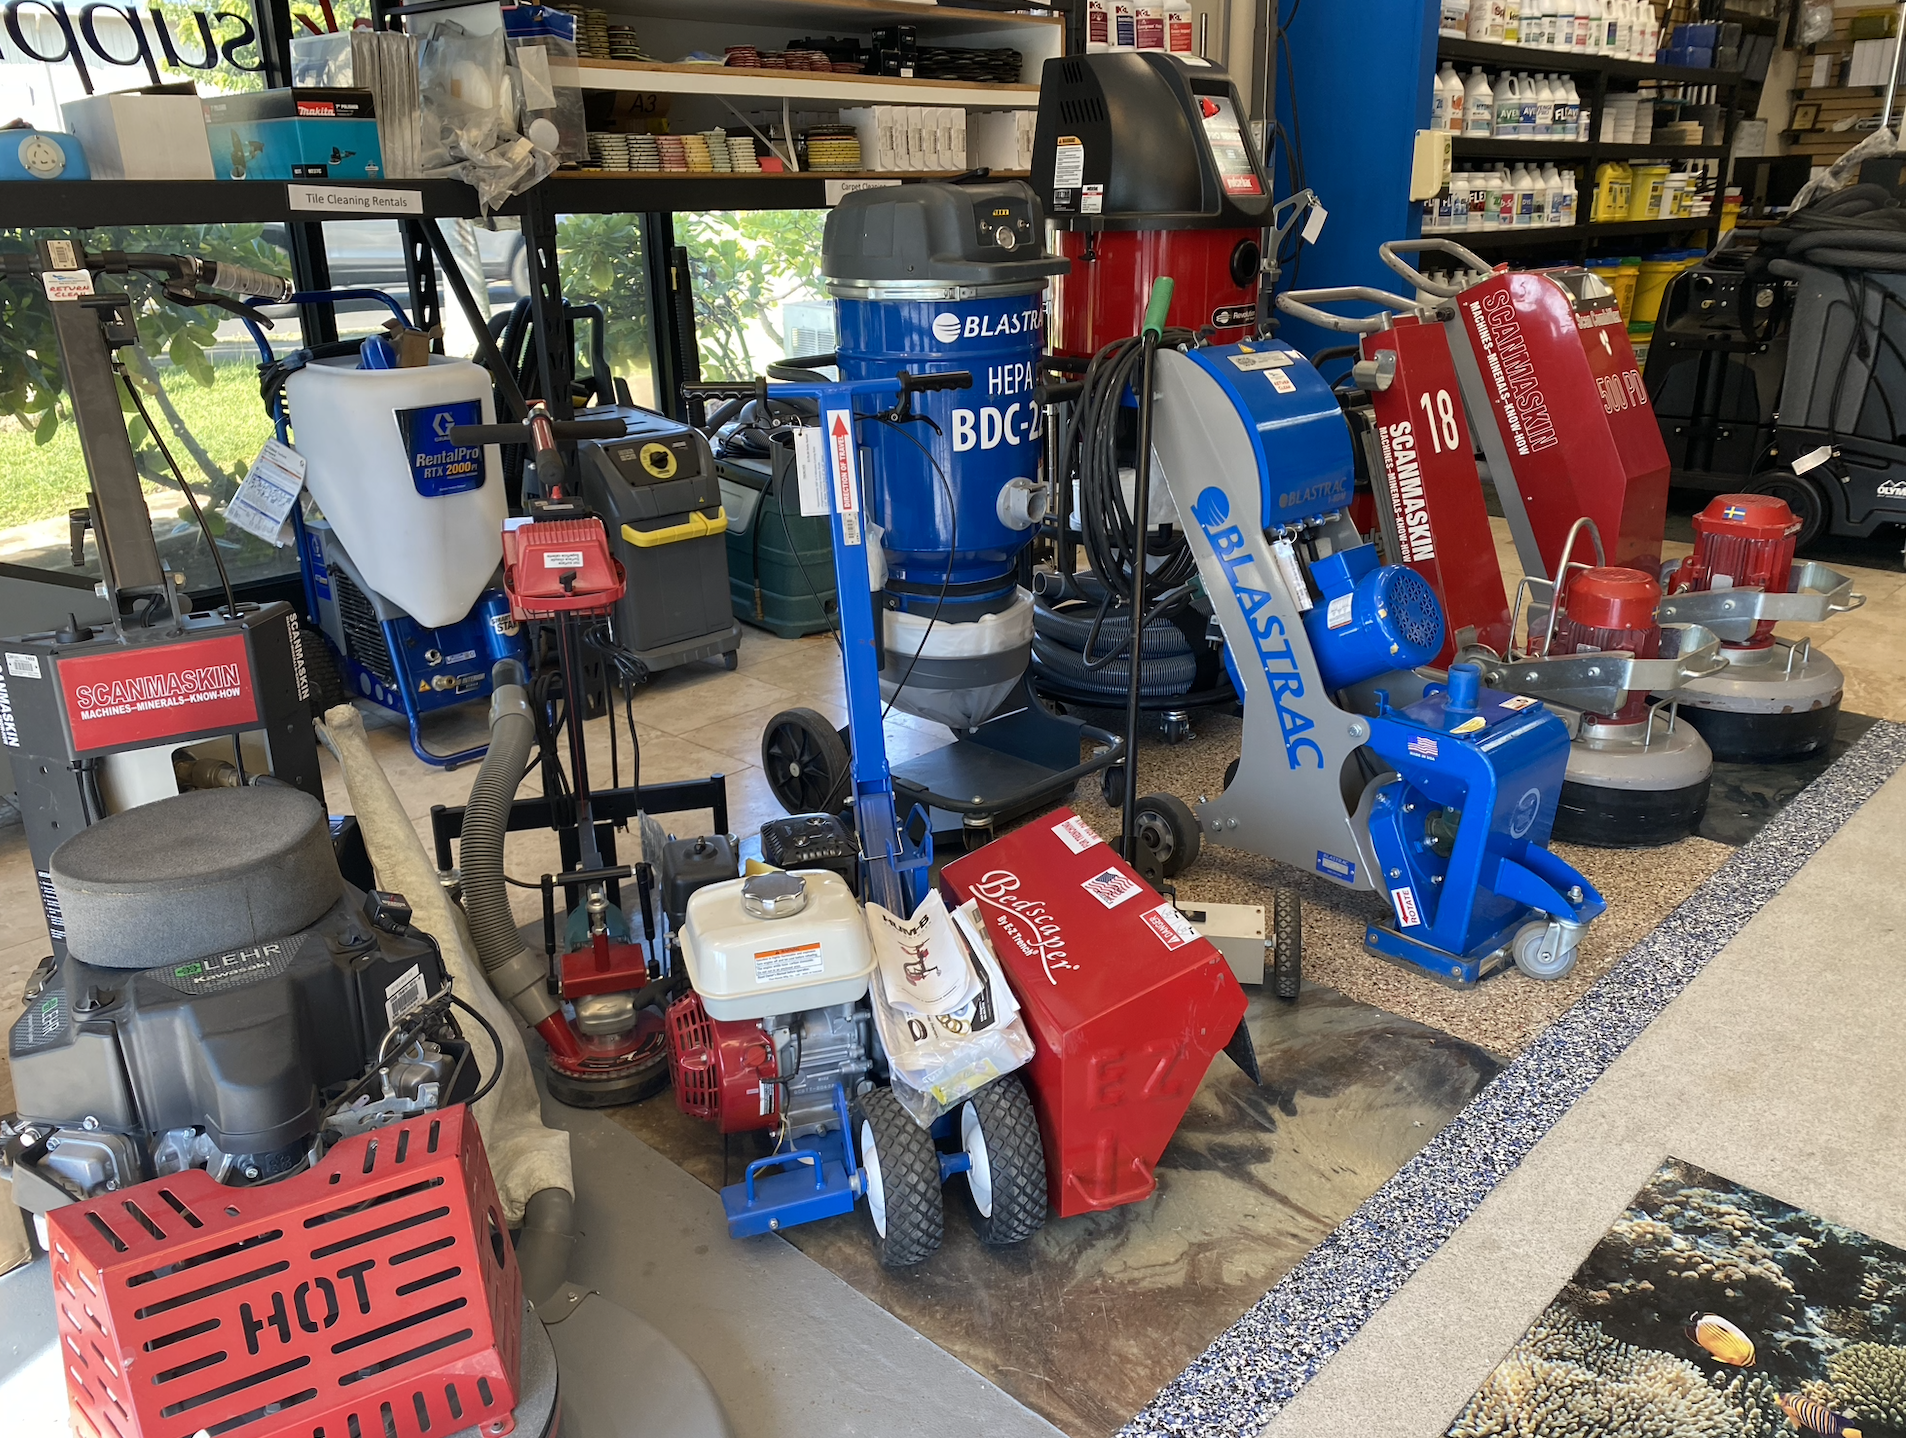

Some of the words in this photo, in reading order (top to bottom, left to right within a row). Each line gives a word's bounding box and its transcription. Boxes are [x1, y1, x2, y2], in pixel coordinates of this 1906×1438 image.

[629, 93, 657, 113] A3
[305, 193, 325, 205] Tile
[327, 194, 370, 208] Cleaning
[372, 196, 408, 208] Rentals
[841, 182, 861, 192] Carpet
[988, 360, 1033, 396] HEPA
[1482, 289, 1559, 453] SCANMASKIN
[1595, 373, 1629, 415] 500
[1621, 369, 1648, 408] PD
[1420, 388, 1460, 454] 18
[415, 447, 479, 468] RentalPro
[837, 435, 846, 462] TRAVEL
[424, 466, 443, 479] RTX
[446, 461, 472, 476] 2000
[840, 462, 847, 472] OF
[840, 471, 851, 508] DIRECTION
[1288, 476, 1347, 507] BLASTRAC
[1389, 421, 1435, 563] SCANMASKIN
[289, 612, 310, 700] SCANMASKIN
[1207, 524, 1325, 771] BLASTRAC
[75, 663, 241, 710] SCANMASKIN
[975, 869, 1074, 975] Bedscaper
[1402, 889, 1418, 924] ROTATE
[996, 914, 1010, 927] By
[1003, 922, 1020, 941] E-Z
[1012, 931, 1033, 957] Trench
[1149, 915, 1173, 938] DANGER
[193, 960, 271, 984] Kawasaki
[203, 944, 281, 971] LEHR
[238, 1258, 376, 1356] HOT
